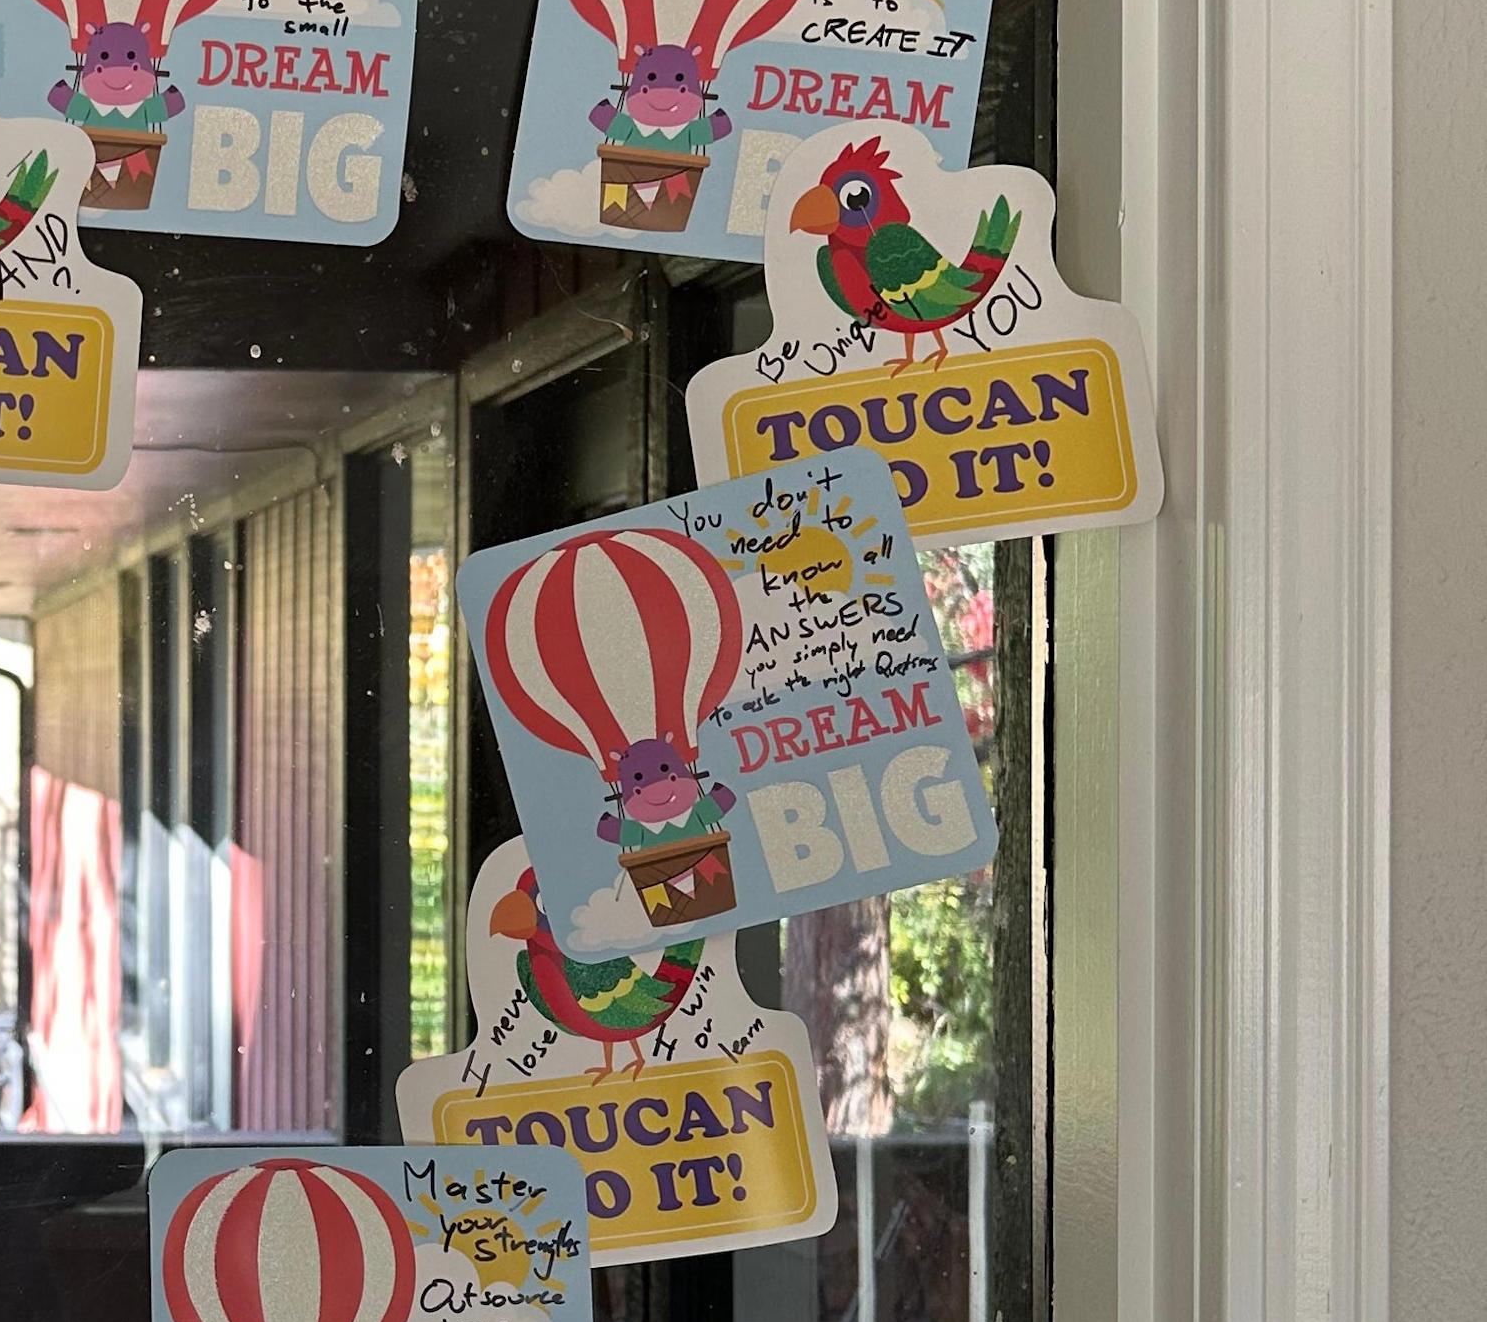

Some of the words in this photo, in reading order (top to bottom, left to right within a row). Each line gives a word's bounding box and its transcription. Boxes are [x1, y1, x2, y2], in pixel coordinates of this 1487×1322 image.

[283, 16, 350, 38] small
[801, 18, 920, 52] CREATE
[924, 31, 978, 60] IT
[196, 40, 391, 98] DREAM
[746, 64, 955, 129] DREAM
[187, 104, 385, 223] BIG
[754, 339, 800, 385] Be
[952, 264, 1043, 353] YOU
[756, 368, 1090, 462] TOUCAN
[948, 439, 1056, 500] IT!
[666, 500, 723, 539] You
[751, 469, 844, 519] don't
[729, 511, 801, 555] need
[821, 504, 853, 533] to
[759, 555, 844, 597] know
[863, 533, 894, 565] all
[745, 591, 905, 655] ANSWERS
[787, 585, 834, 613] the
[743, 657, 778, 690] you
[792, 636, 858, 667] simply
[871, 613, 921, 644] need
[741, 685, 781, 714] ask
[784, 669, 813, 692] the
[821, 659, 868, 699] right
[729, 681, 943, 775] DREAM
[746, 745, 979, 895] BIG
[679, 963, 717, 1018] win
[505, 1028, 559, 1077] lose
[651, 1022, 678, 1062] I
[694, 1016, 713, 1049] or
[717, 1016, 767, 1064] learn
[461, 1048, 492, 1099] I
[402, 1158, 549, 1205] Master
[649, 1151, 748, 1211] IT!
[440, 1213, 509, 1253] your
[419, 1278, 567, 1316] Outsource
